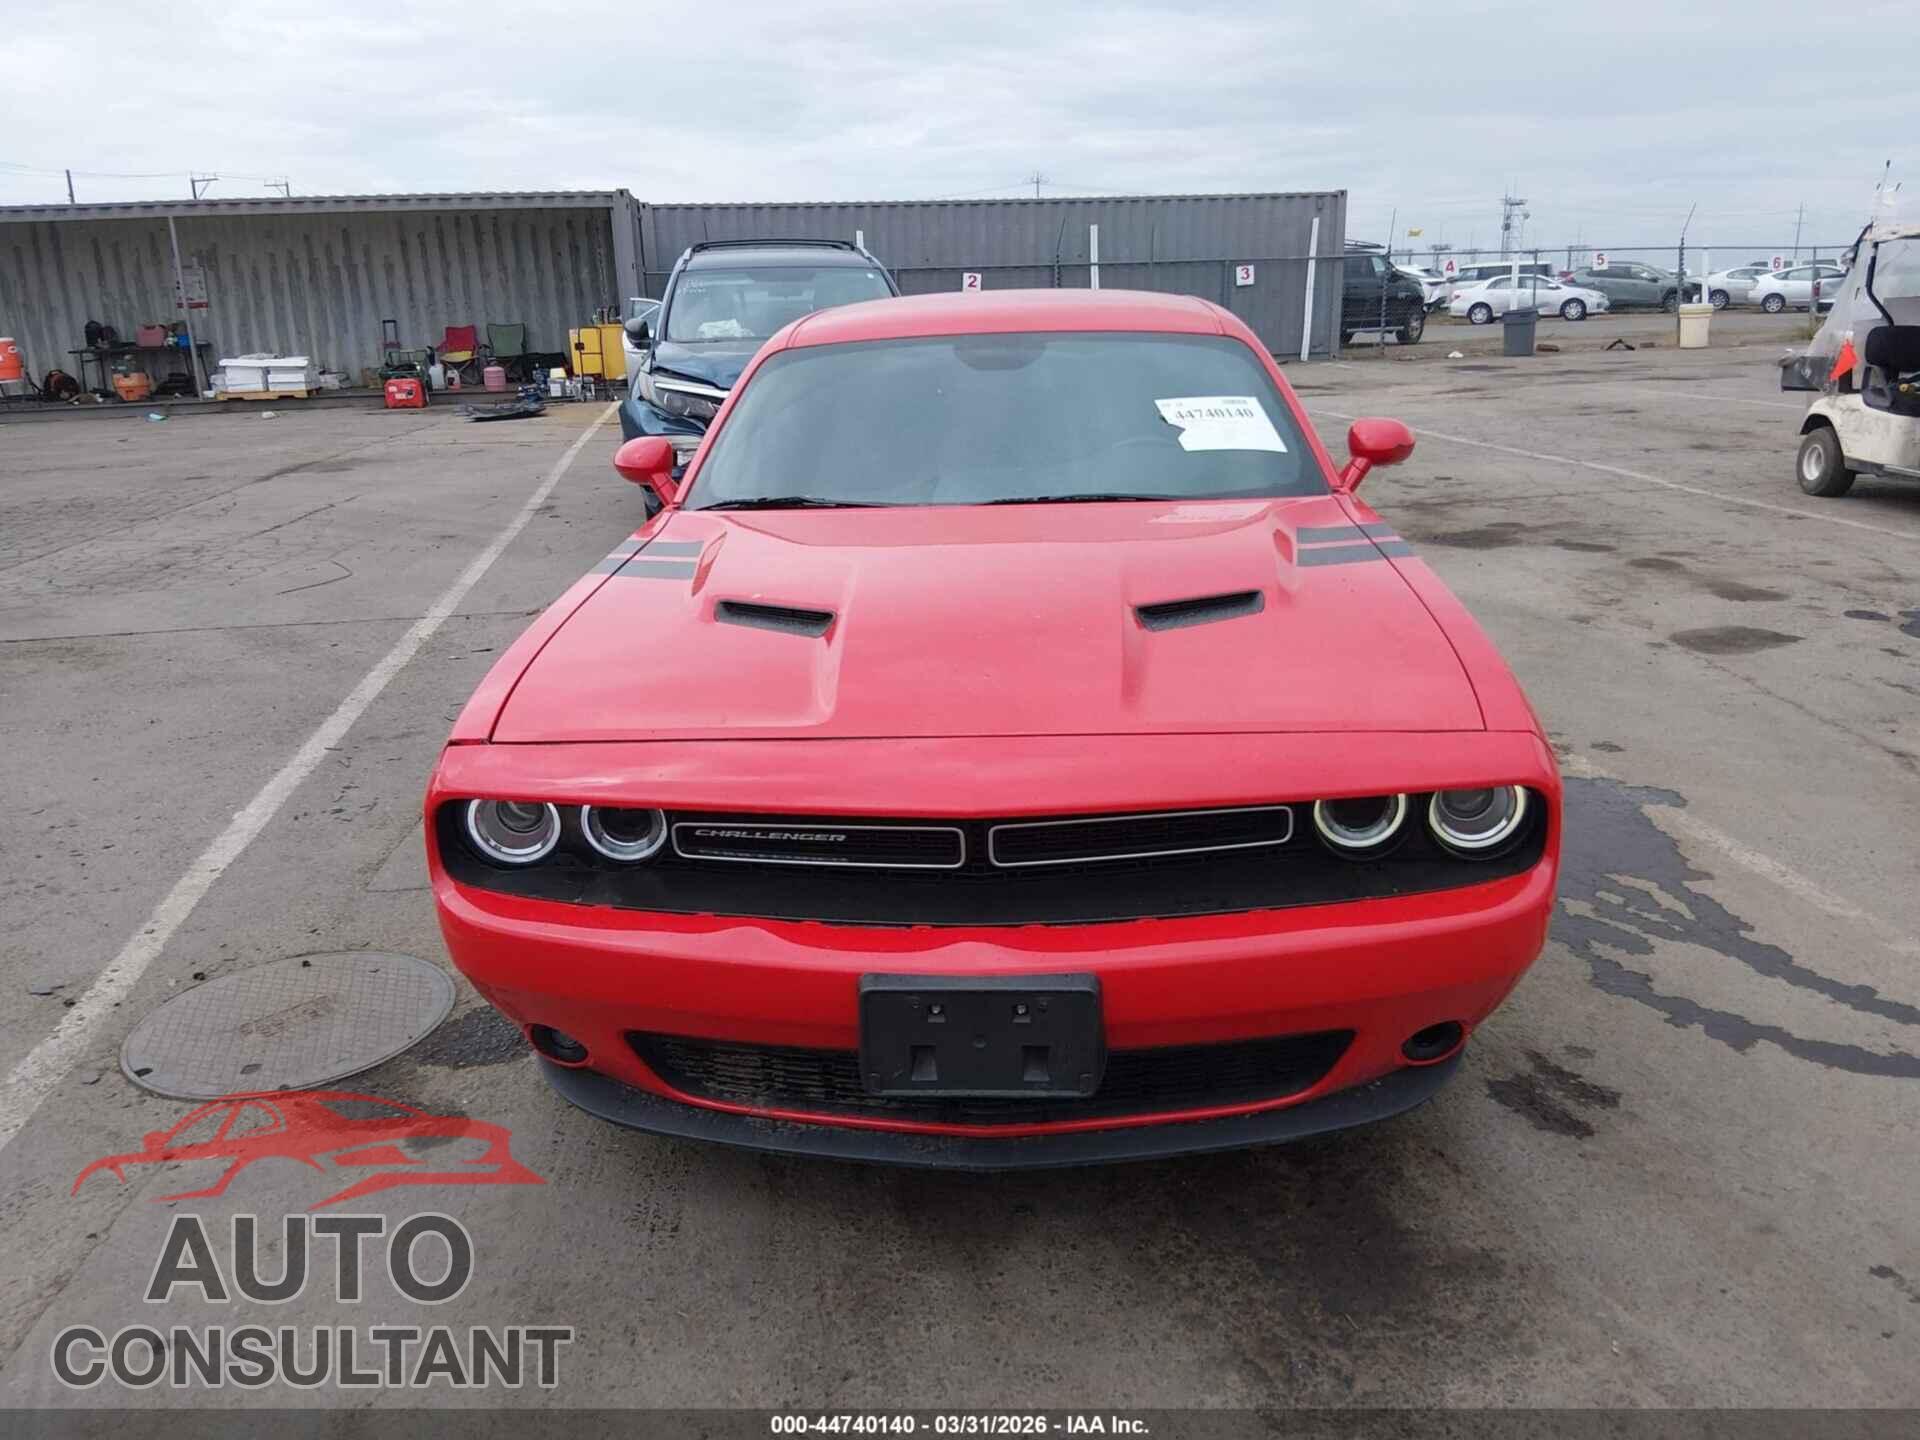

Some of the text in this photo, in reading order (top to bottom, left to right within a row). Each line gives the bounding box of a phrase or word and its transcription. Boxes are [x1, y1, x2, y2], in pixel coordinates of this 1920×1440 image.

[1446, 260, 1455, 272] 4
[1597, 253, 1605, 266] 5
[1773, 256, 1781, 269] 6
[1241, 267, 1250, 280] 3
[967, 274, 977, 288] 2
[1175, 407, 1254, 420] 44740140
[695, 828, 847, 842] CHALLENGER
